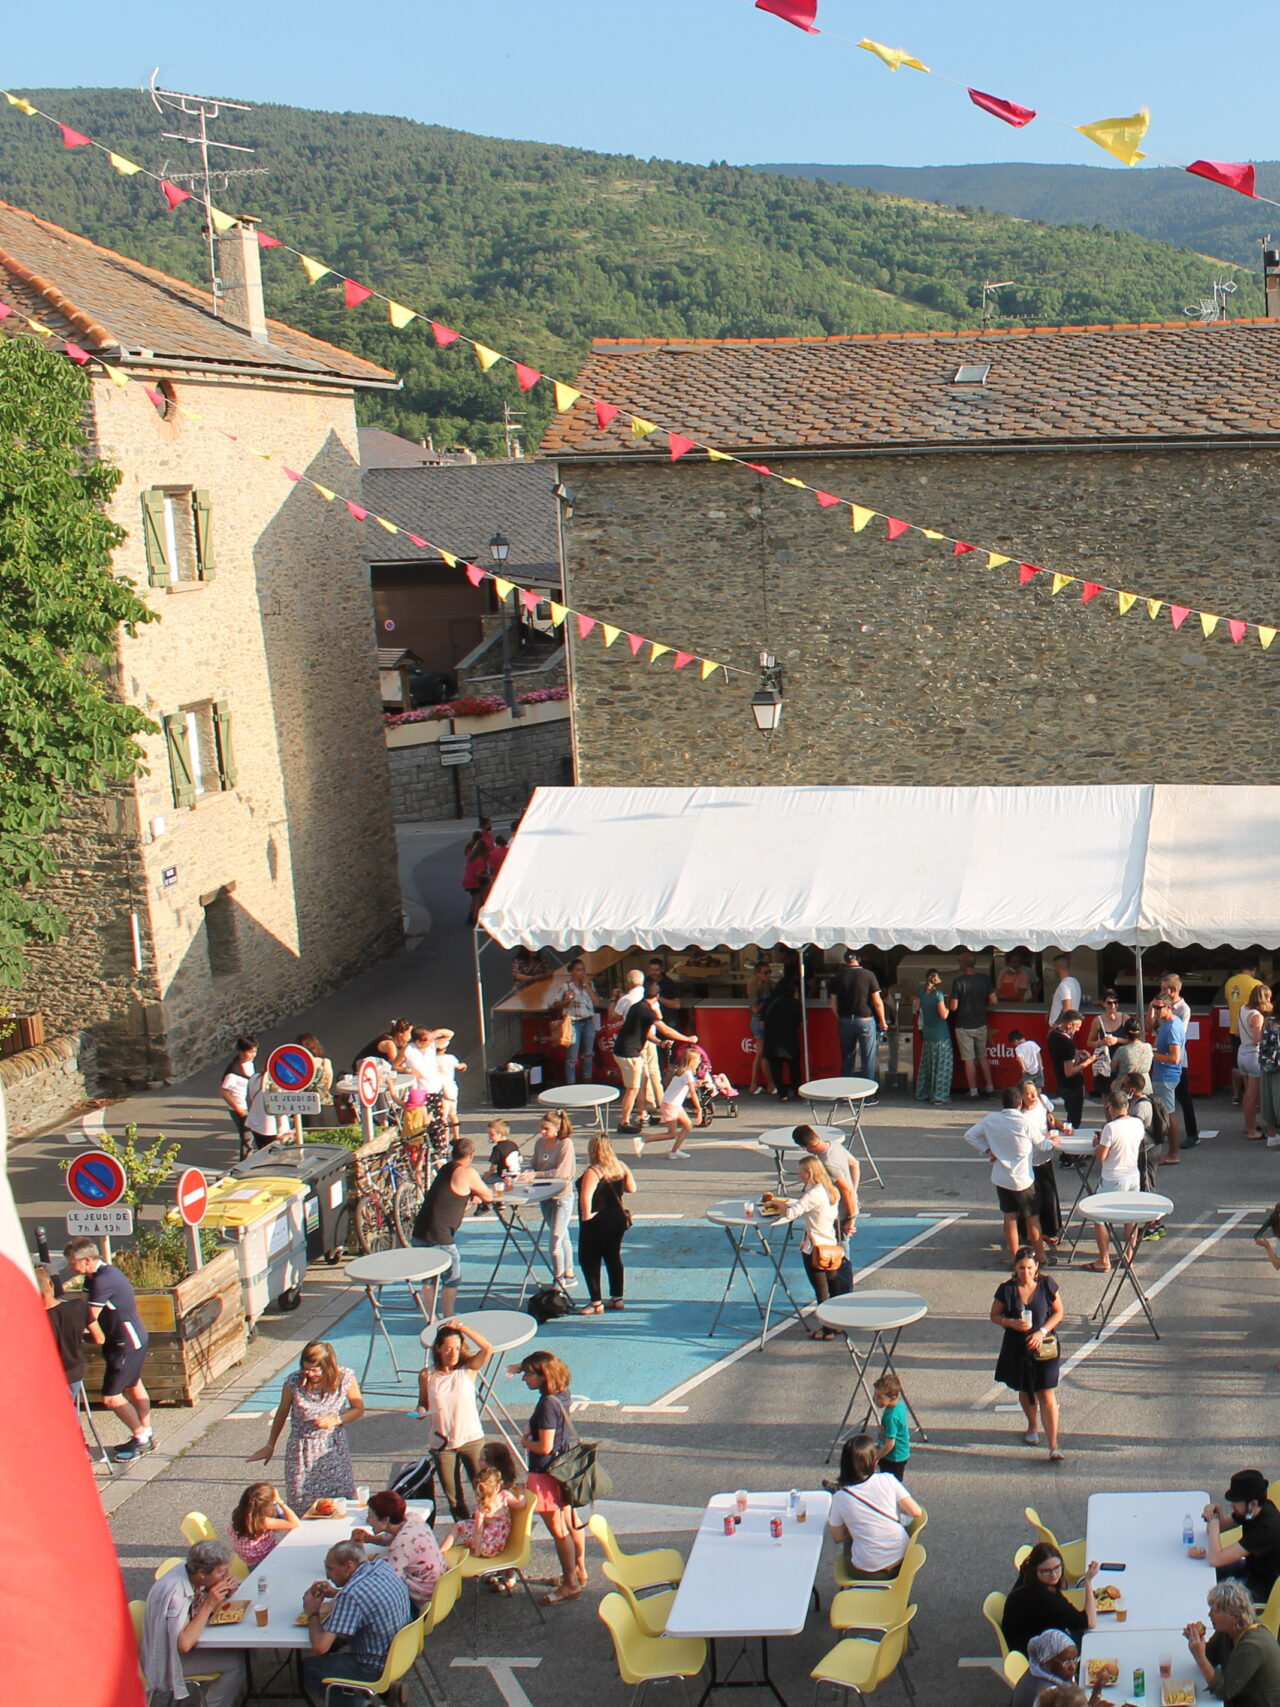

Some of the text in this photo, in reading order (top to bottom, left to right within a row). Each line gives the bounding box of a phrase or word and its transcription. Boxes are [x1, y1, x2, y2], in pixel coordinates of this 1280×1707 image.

[984, 1043, 1015, 1058] rella
[68, 1213, 128, 1221] LE JEUDI DE
[78, 1224, 90, 1232] 7h
[104, 1224, 121, 1232] 13h
